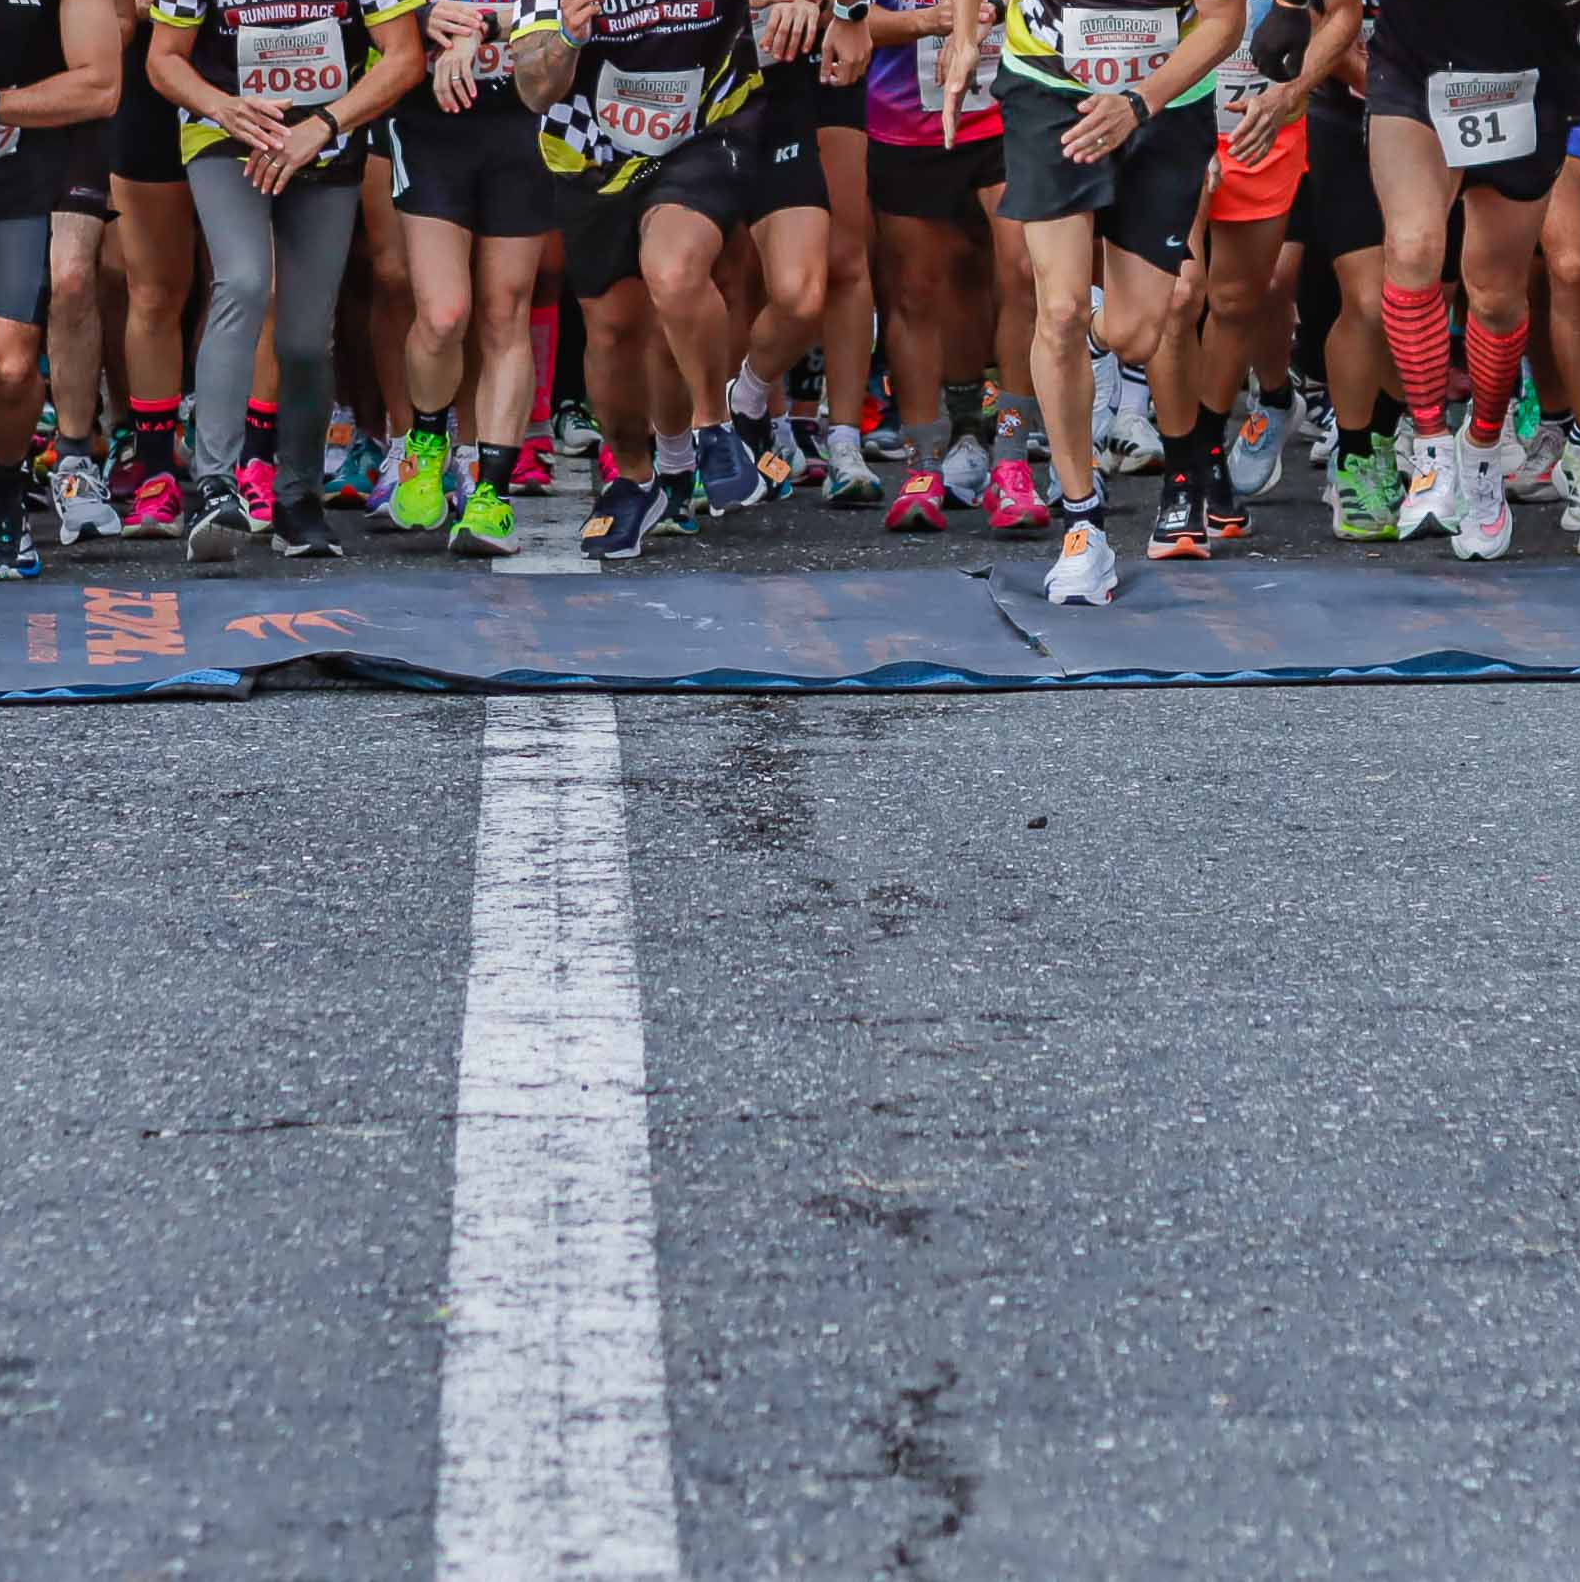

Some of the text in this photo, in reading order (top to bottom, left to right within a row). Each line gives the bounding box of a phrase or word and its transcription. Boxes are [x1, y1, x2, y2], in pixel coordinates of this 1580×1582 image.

[239, 3, 336, 24] RUNNING RACE
[608, 3, 699, 33] RUNNING RACE
[242, 65, 343, 94] 4080
[599, 102, 692, 140] 4064
[1458, 112, 1507, 148] 81
[776, 142, 800, 163] K1
